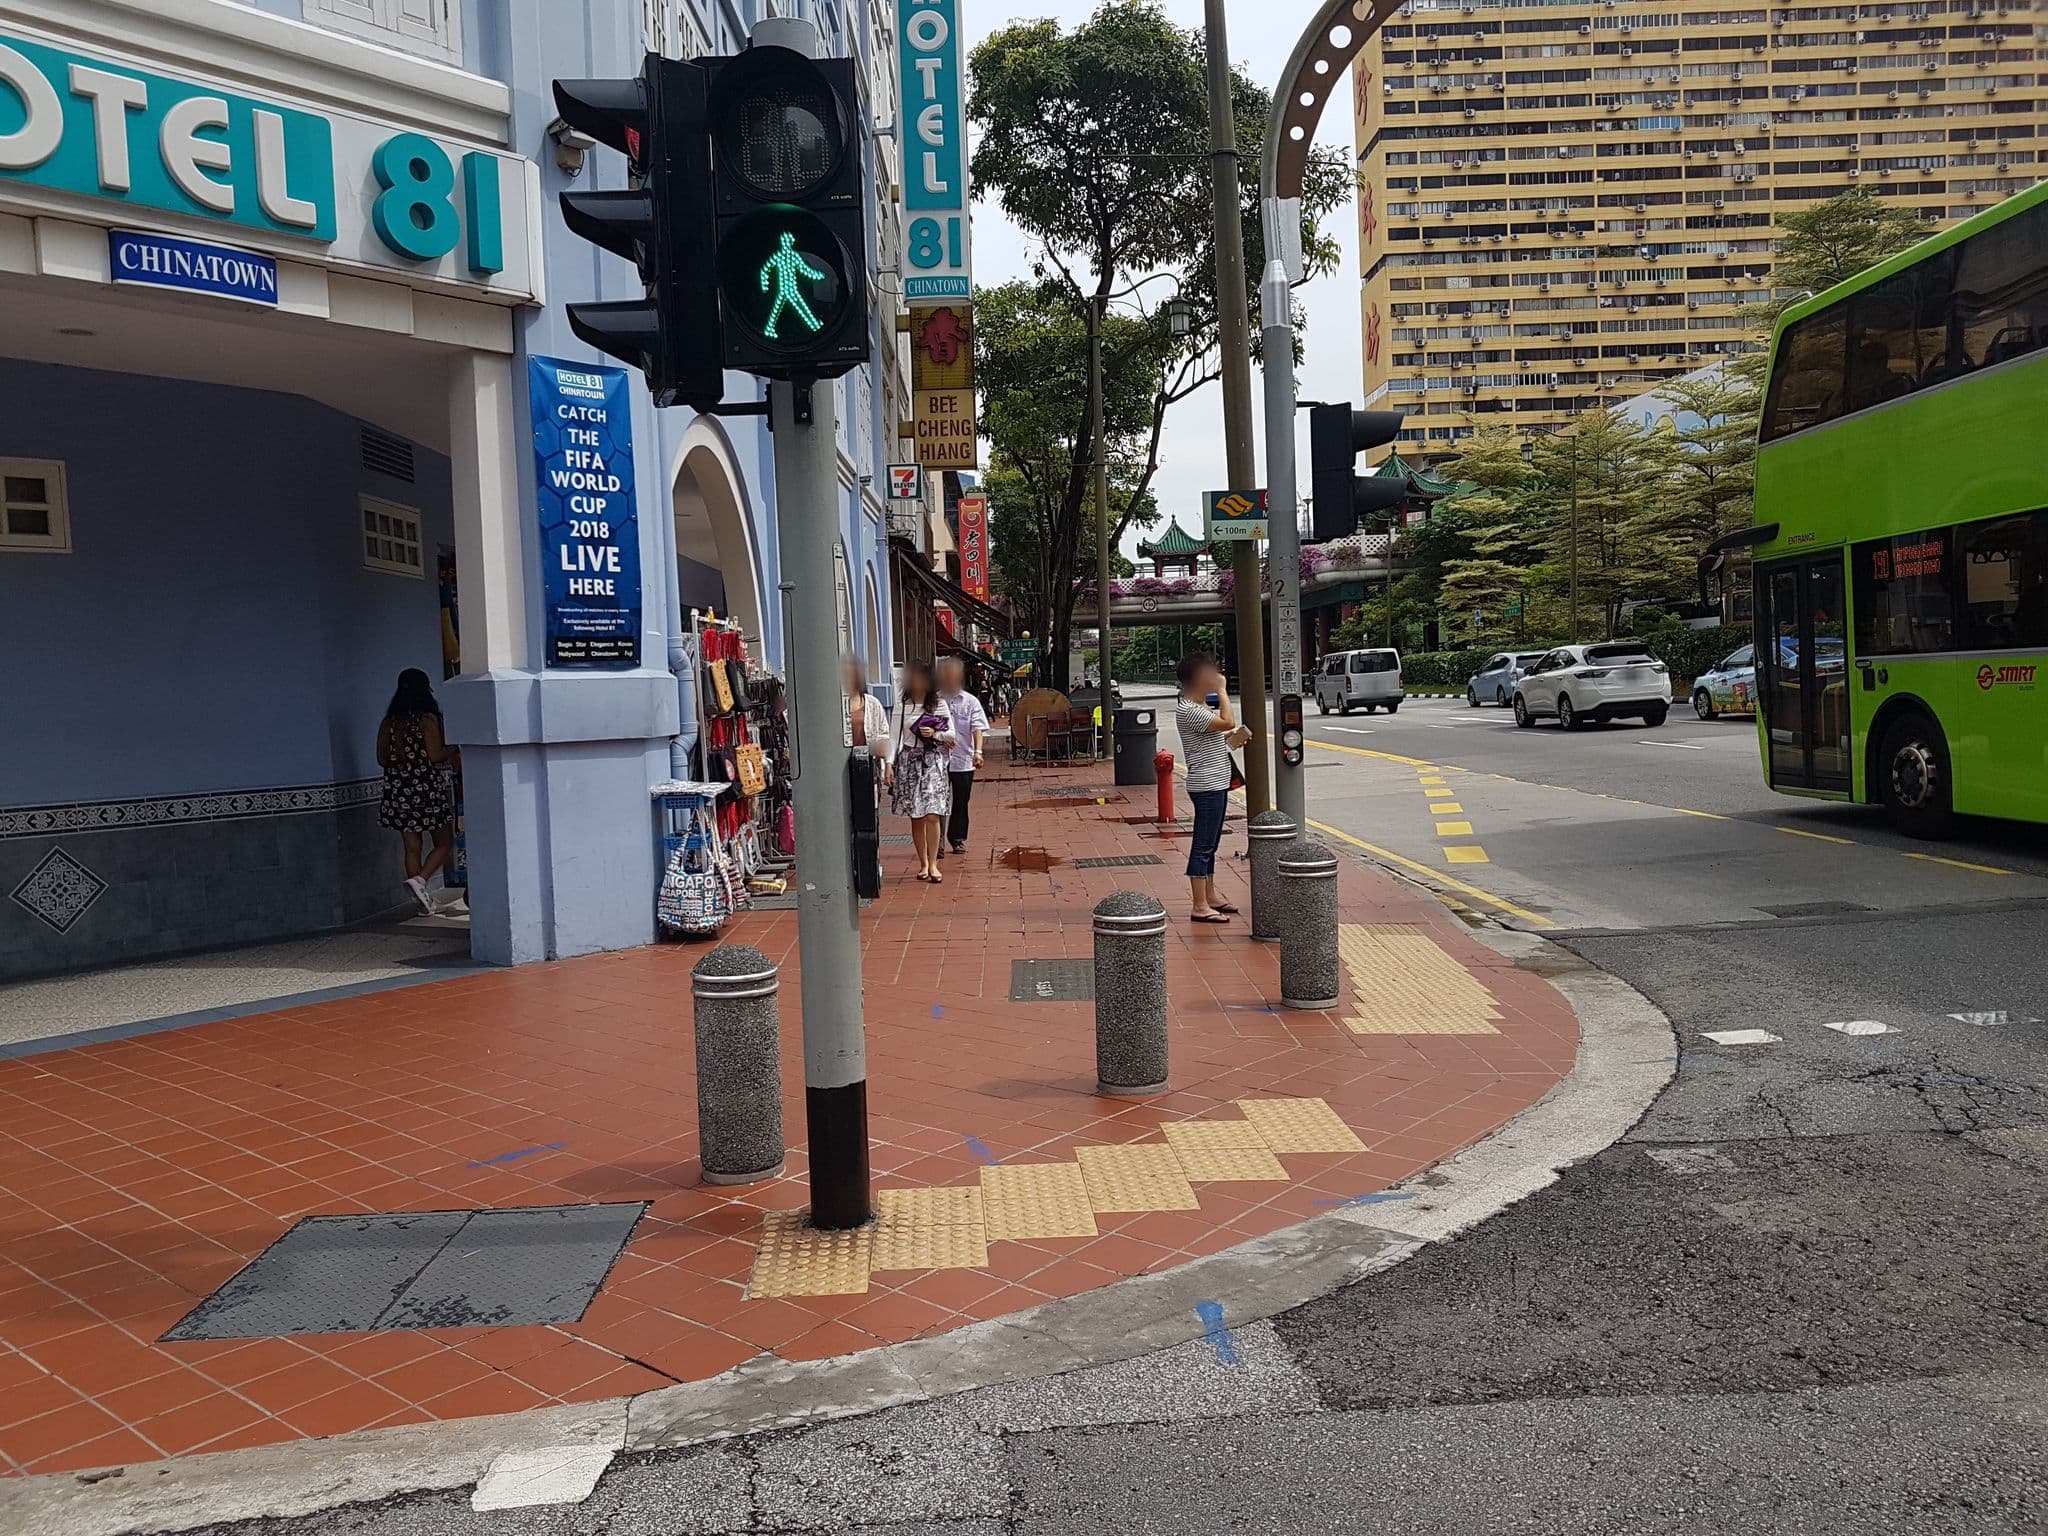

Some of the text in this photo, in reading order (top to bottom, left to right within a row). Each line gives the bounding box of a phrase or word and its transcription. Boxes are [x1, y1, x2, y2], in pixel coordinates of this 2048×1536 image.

[907, 0, 948, 193] OTEL
[372, 132, 503, 274] 81
[908, 216, 962, 269] 81
[119, 241, 275, 292] CHINATOWN
[907, 279, 967, 294] CHINATOWN
[559, 371, 587, 386] HOTEL
[559, 386, 605, 400] CHINATOWN
[558, 404, 607, 423] CATCH
[929, 396, 958, 414] BEE
[567, 428, 600, 447] THE
[918, 419, 971, 438] CHENG
[565, 449, 606, 471] FIFA
[919, 442, 971, 461] HIANG
[551, 470, 621, 493] WORLD
[570, 496, 607, 515] CUP
[569, 520, 610, 539] 2018
[1224, 526, 1247, 536] 100m
[1787, 532, 1816, 546] ENTRANCE
[561, 543, 622, 573] LIVE
[569, 578, 616, 596] HERE
[1996, 666, 2037, 682] SMRT
